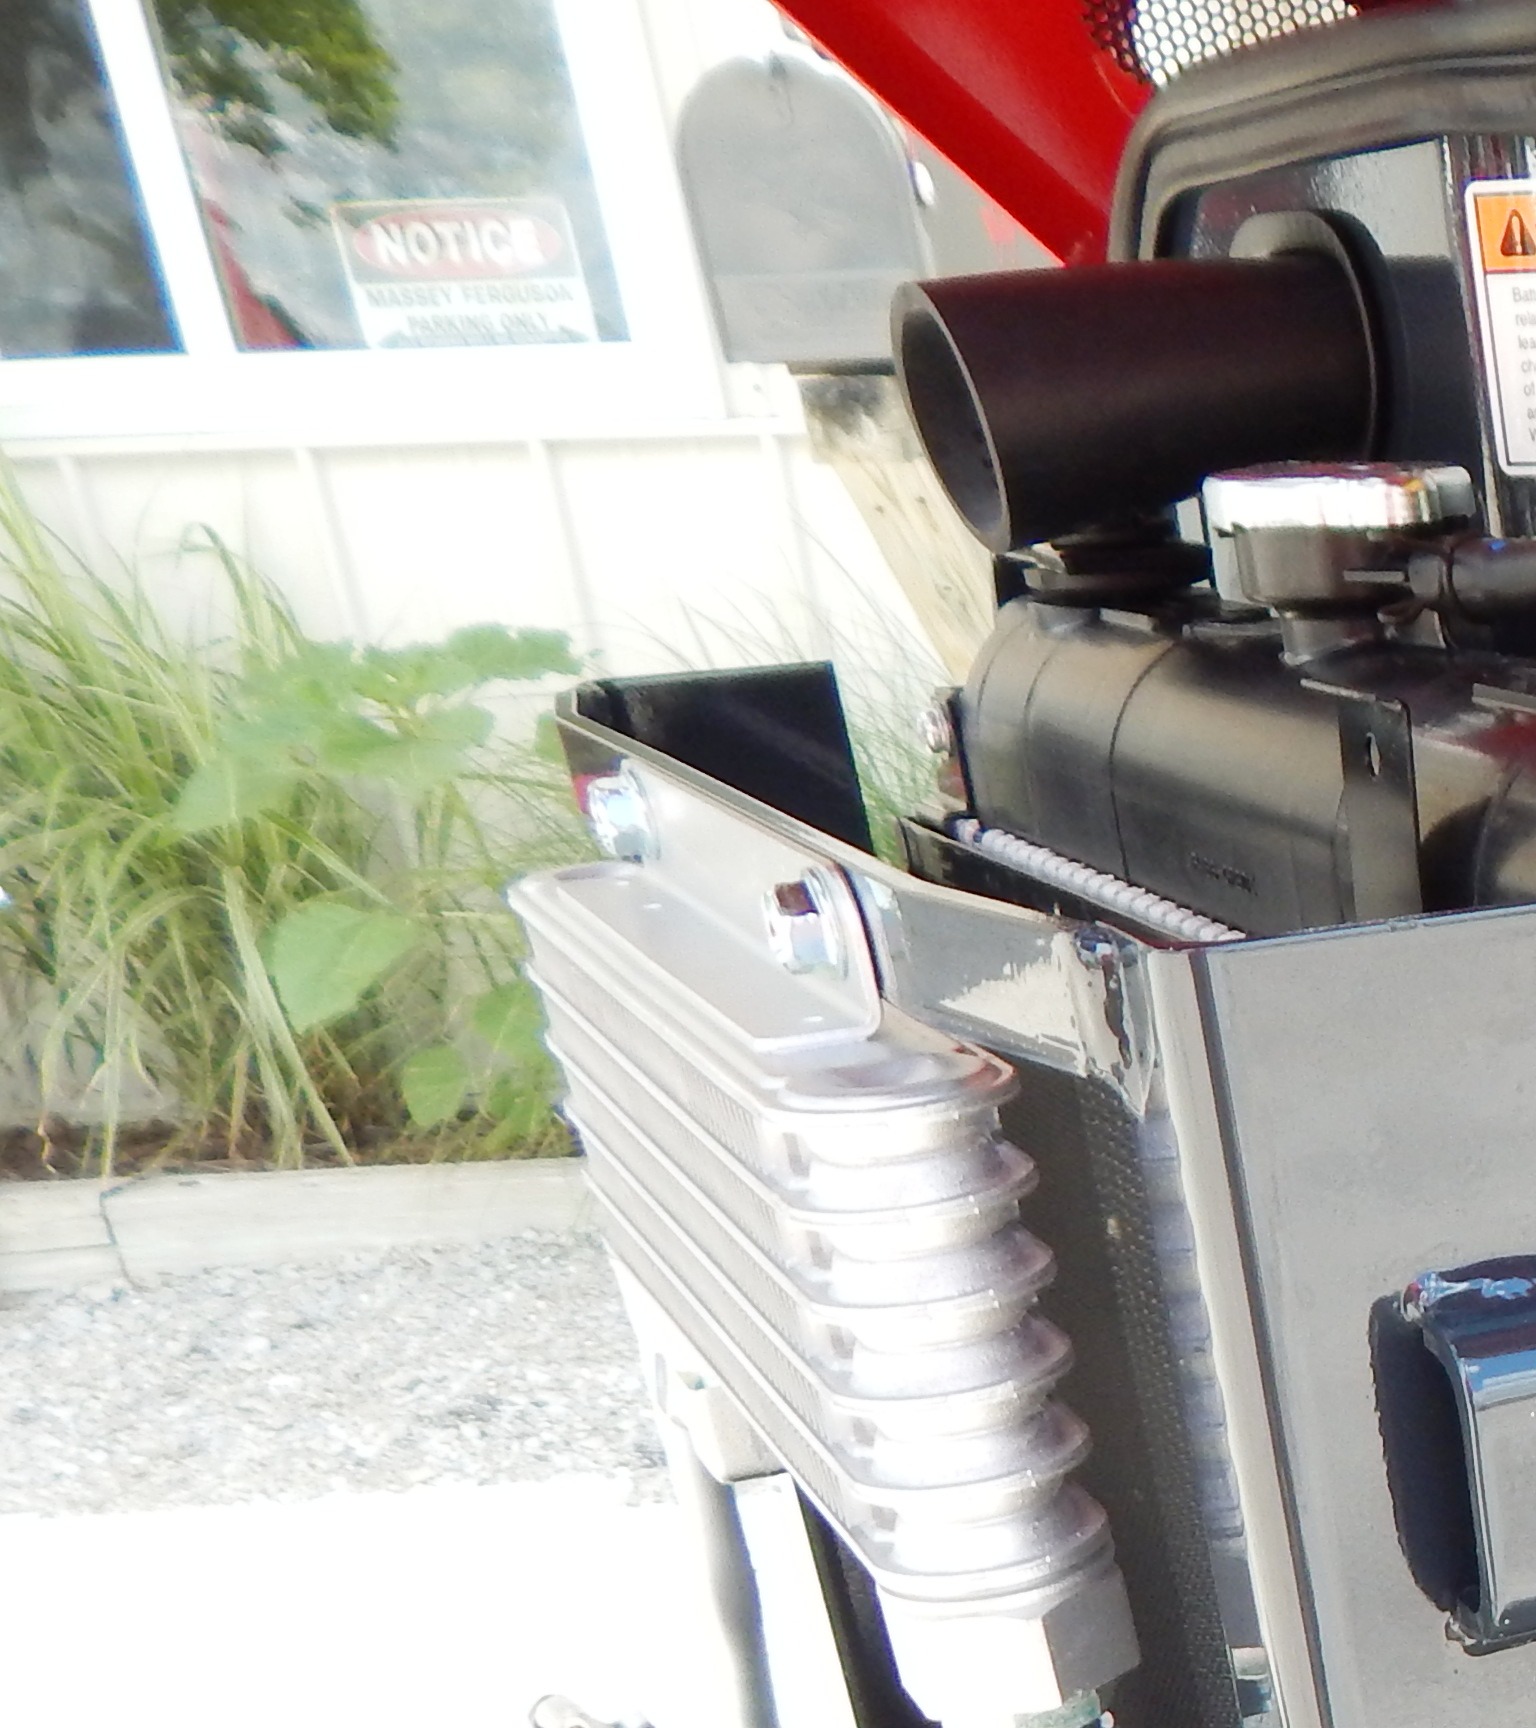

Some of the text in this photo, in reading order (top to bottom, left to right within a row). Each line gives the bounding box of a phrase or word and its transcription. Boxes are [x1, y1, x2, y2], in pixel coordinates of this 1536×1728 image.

[370, 218, 547, 266] NOTICE
[366, 284, 452, 308] MASSEY
[1524, 381, 1536, 397] of
